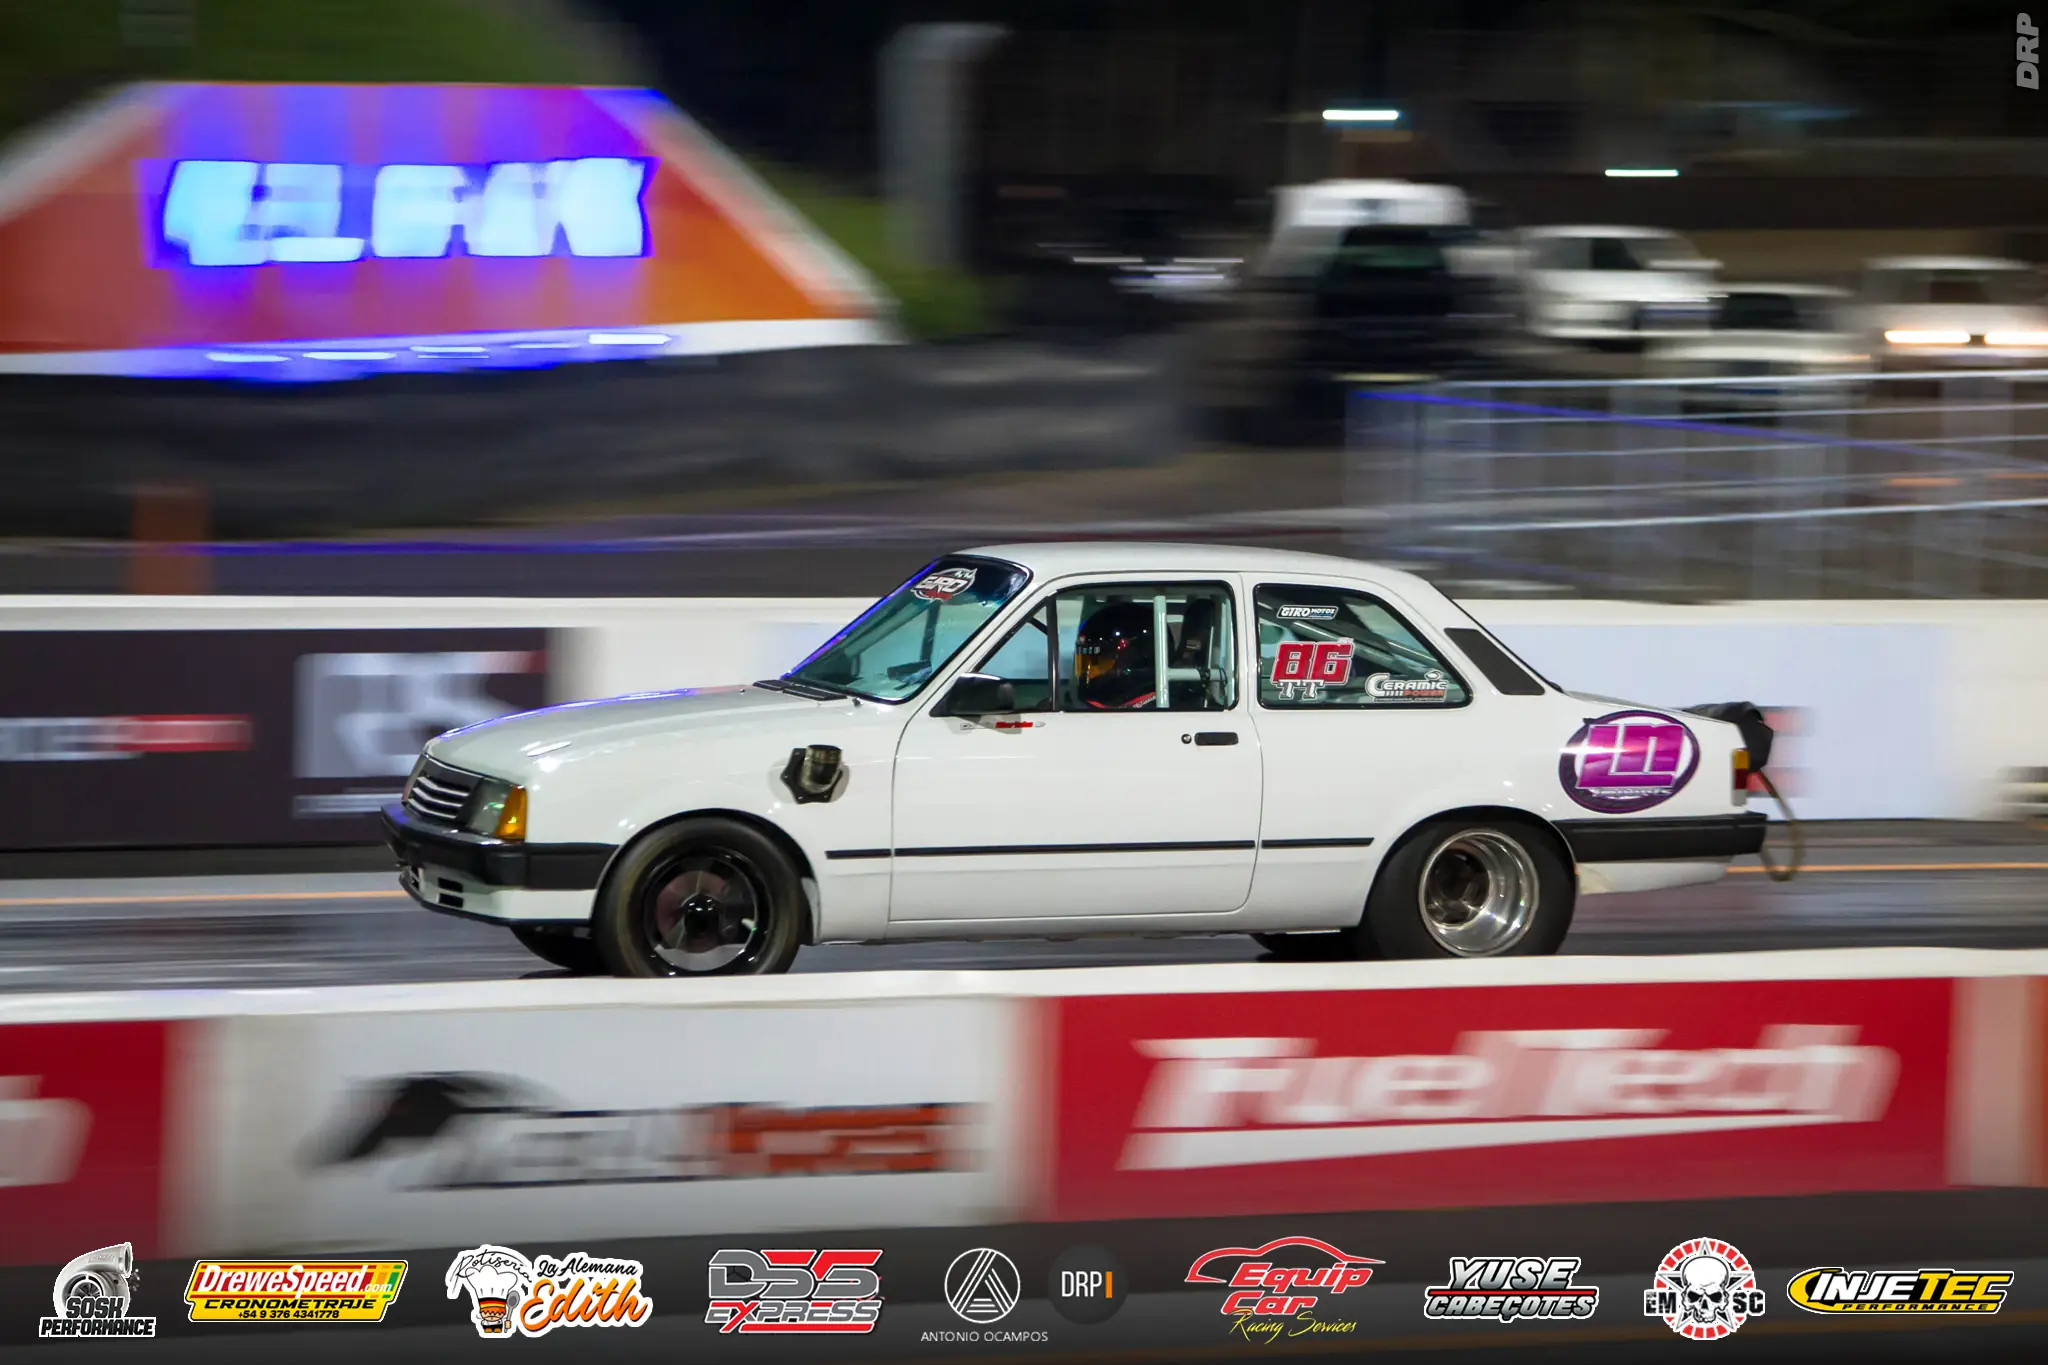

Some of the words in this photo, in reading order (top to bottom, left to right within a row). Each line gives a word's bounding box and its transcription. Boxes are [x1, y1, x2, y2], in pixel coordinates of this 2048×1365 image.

[1281, 607, 1311, 617] GIRO
[1271, 641, 1354, 685] 86
[1366, 674, 1449, 697] CERAMIC
